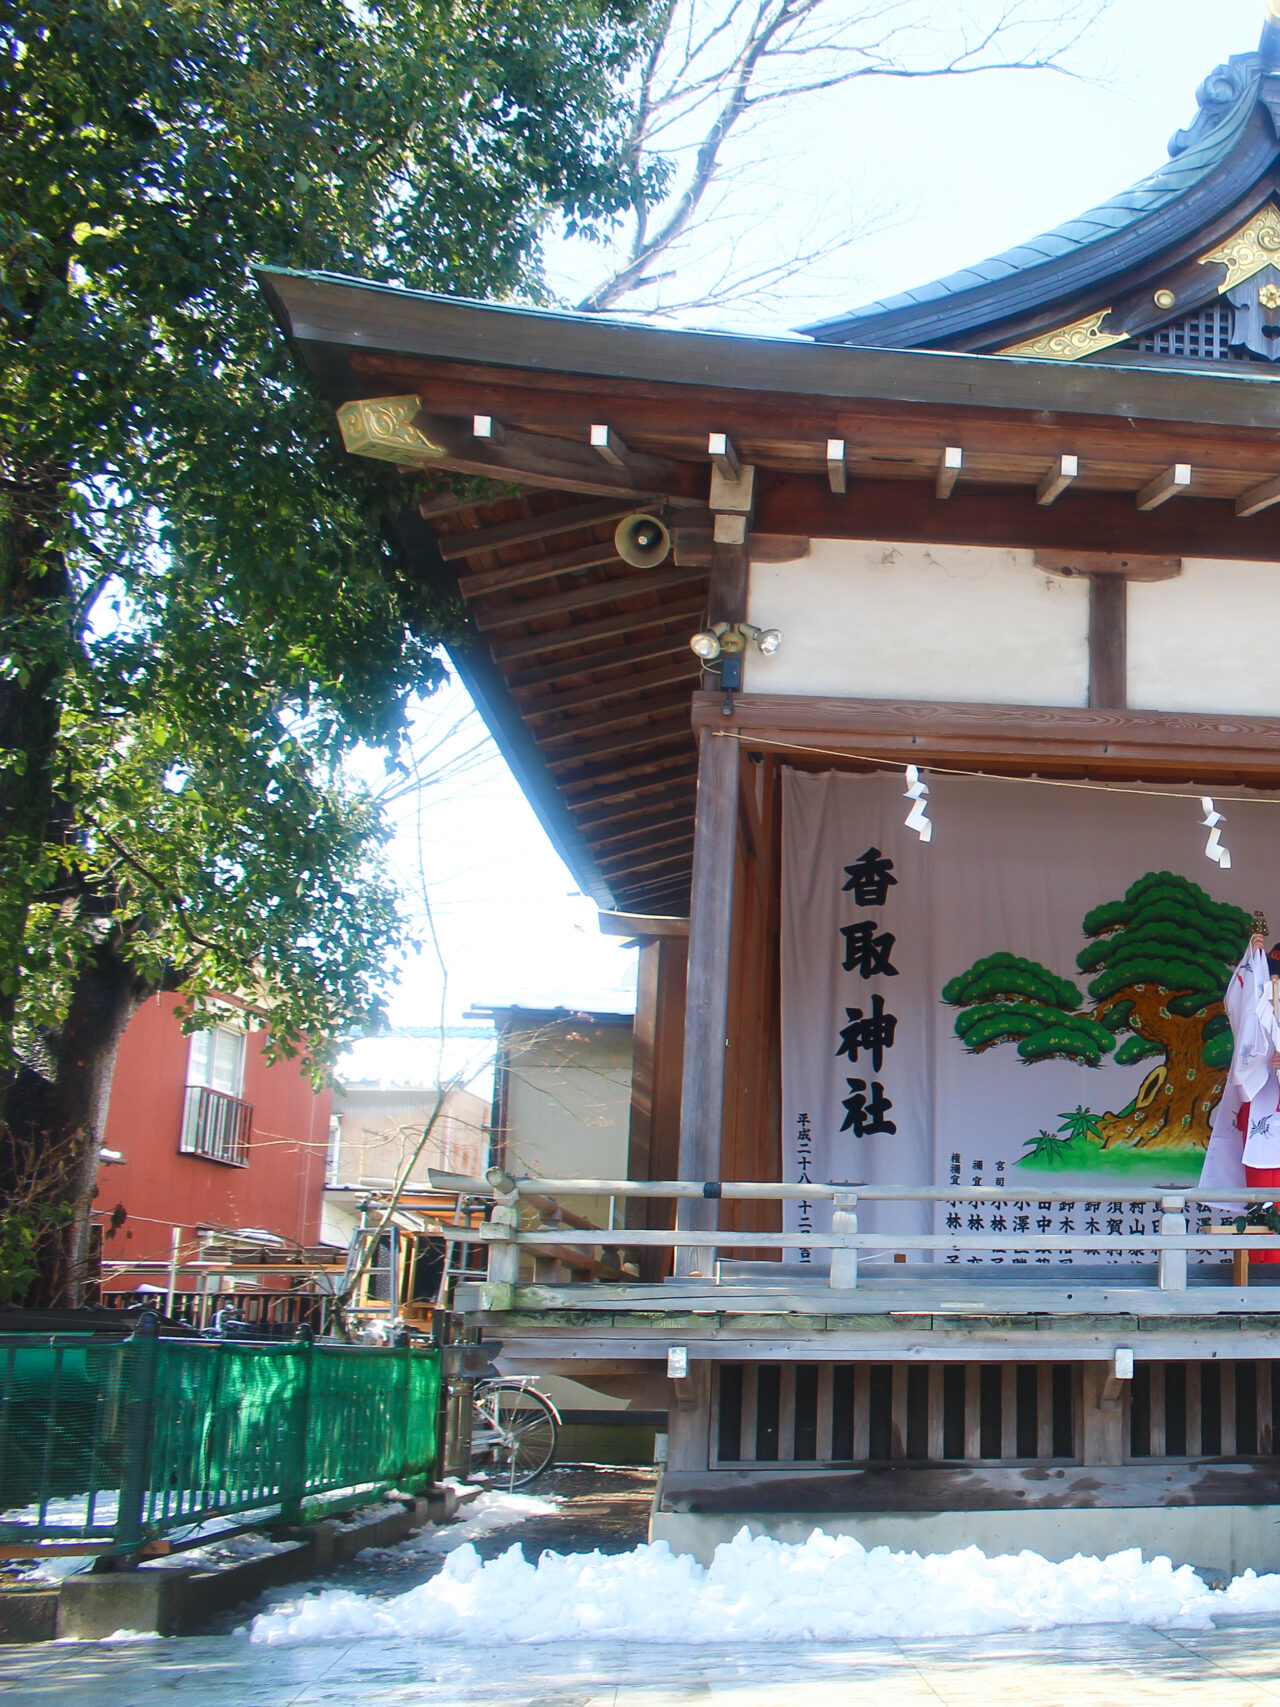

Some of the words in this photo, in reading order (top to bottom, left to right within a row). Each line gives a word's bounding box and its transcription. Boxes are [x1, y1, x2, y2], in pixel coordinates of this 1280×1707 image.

[836, 847, 899, 1138] 香取神社
[995, 1161, 1006, 1186] 宮司
